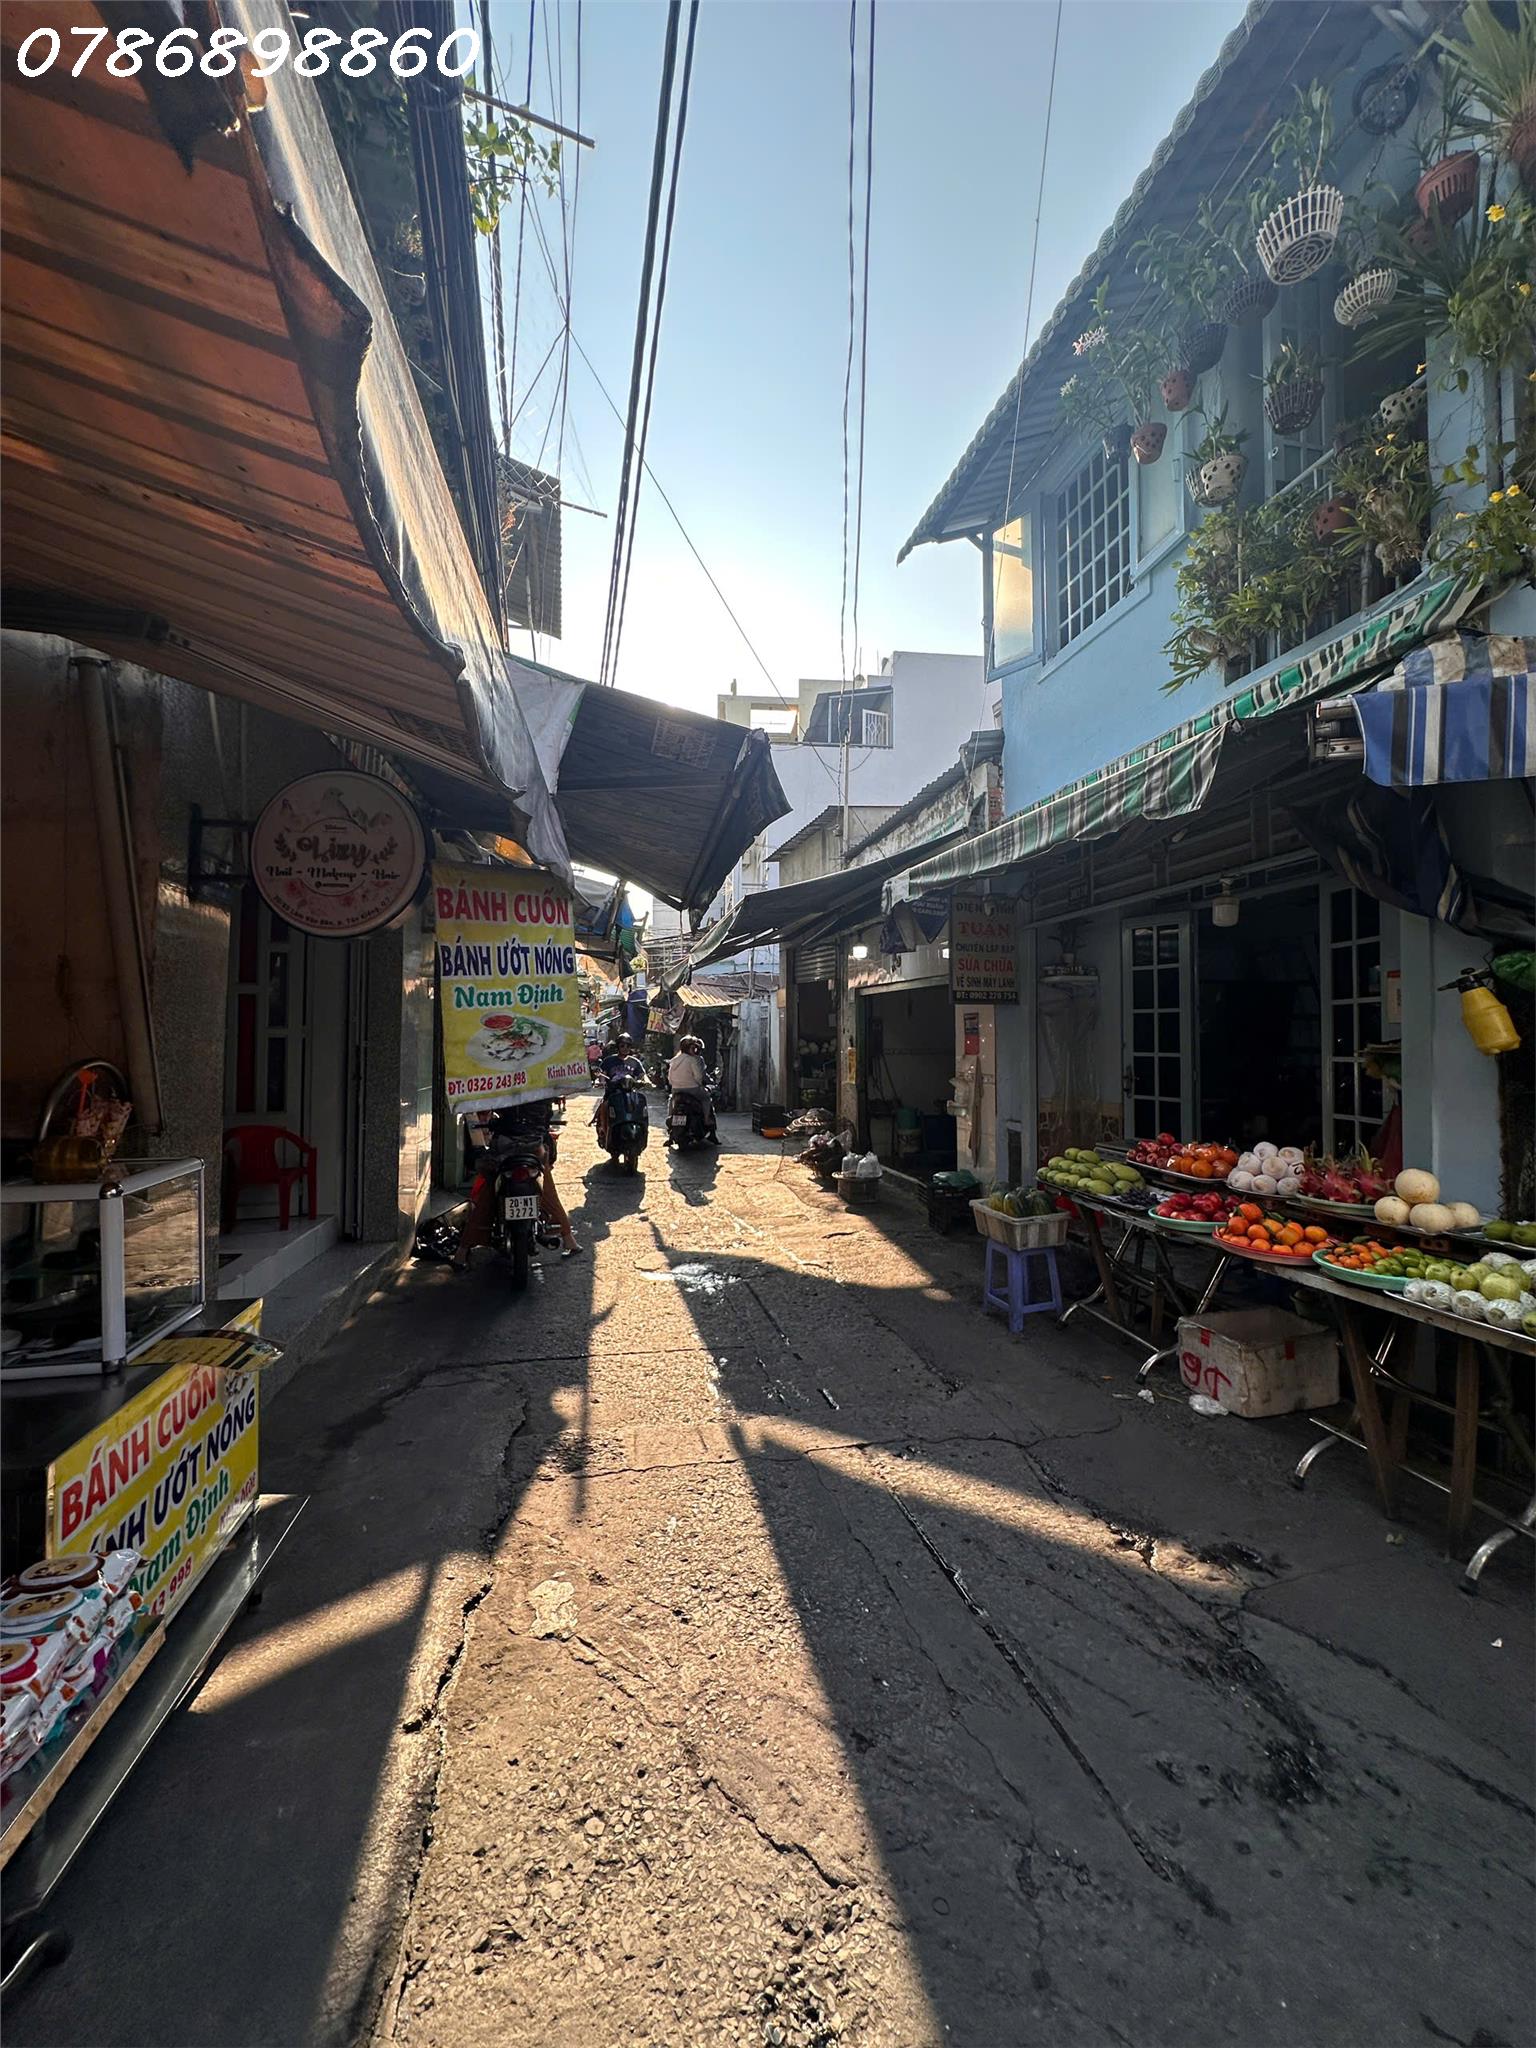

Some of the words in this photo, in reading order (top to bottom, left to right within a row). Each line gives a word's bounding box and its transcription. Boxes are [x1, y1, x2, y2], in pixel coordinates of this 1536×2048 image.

[436, 880, 507, 922] BÁNH
[514, 887, 570, 925] CUỐN
[441, 936, 492, 977] BÁNH
[497, 938, 530, 976] ƯỚT
[534, 938, 575, 976] NÓNG
[455, 985, 512, 1008] Nam
[518, 983, 564, 1010] Định
[448, 1081, 465, 1096] ĐT:
[467, 1077, 493, 1093] 0326
[495, 1074, 511, 1090] 243
[567, 1062, 586, 1077] Mời
[509, 1207, 533, 1218] 3272
[61, 1443, 150, 1541] BÁNH
[157, 1364, 217, 1448] CUỐN
[153, 1443, 202, 1526] ƯỚT
[206, 1387, 255, 1471] NÓNG
[186, 1469, 230, 1540] Định
[170, 1556, 192, 1599] 998
